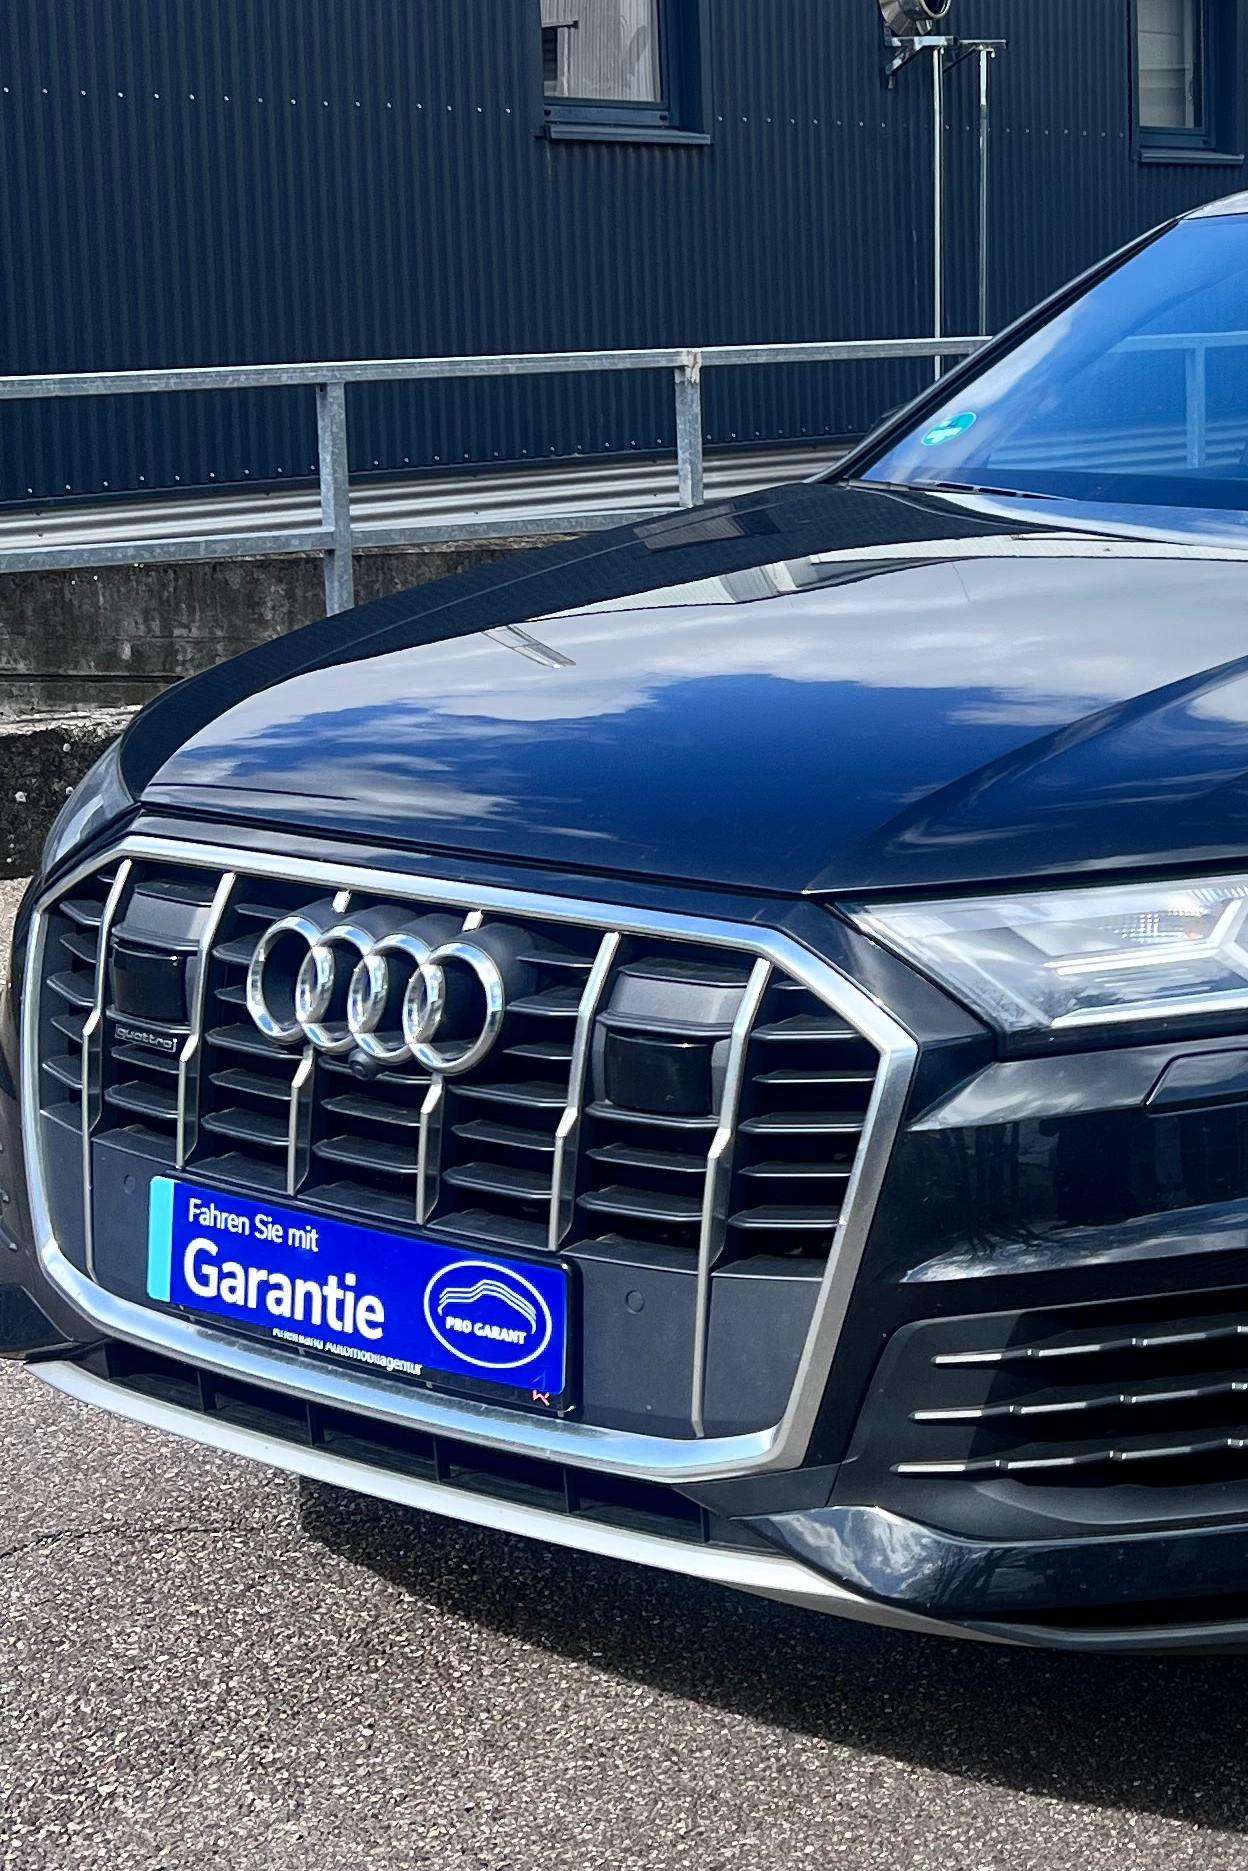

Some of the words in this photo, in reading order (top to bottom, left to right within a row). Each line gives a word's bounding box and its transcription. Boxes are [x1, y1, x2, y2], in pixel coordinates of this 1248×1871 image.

[115, 1023, 178, 1052] quattro
[189, 1197, 250, 1236] Fahren
[254, 1213, 284, 1243] Sie
[288, 1225, 319, 1253] mit
[183, 1237, 385, 1340] Garantie
[445, 1315, 473, 1334] PRO
[473, 1322, 527, 1345] GARANT
